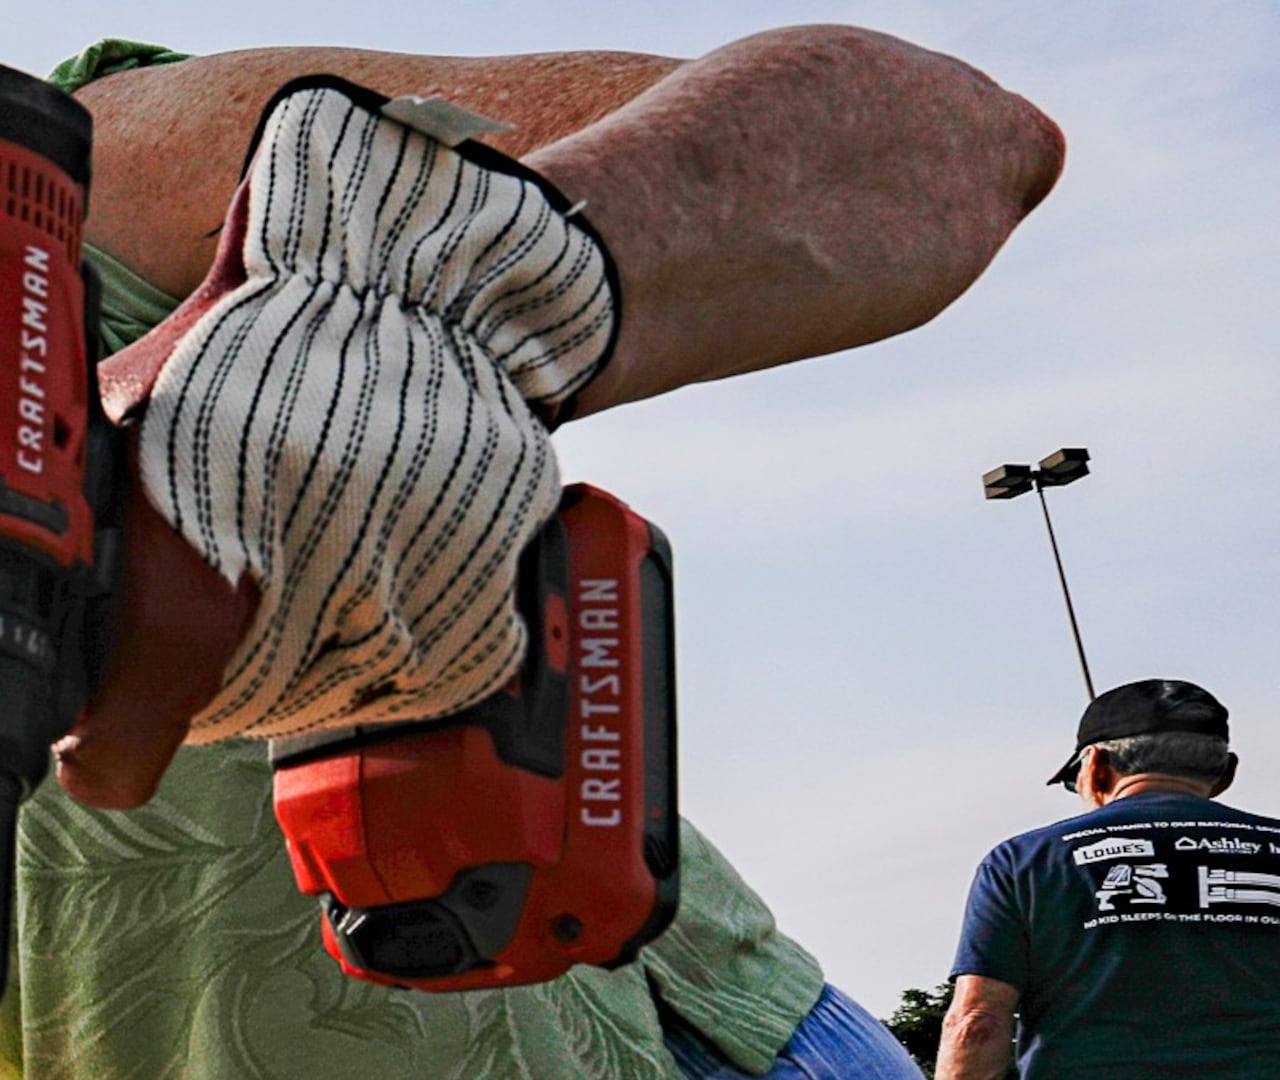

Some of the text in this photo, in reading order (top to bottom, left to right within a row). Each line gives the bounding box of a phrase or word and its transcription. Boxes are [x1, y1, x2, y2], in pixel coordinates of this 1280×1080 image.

[17, 245, 51, 475] CRAFTSMAN
[579, 578, 622, 828] CRAFTSMAN
[1153, 821, 1170, 829] TO
[1082, 843, 1146, 860] LOWE'S
[1198, 836, 1262, 855] Ashley
[1083, 918, 1098, 930] NO
[1098, 915, 1120, 925] KID
[1120, 912, 1162, 922] SLEEPS
[1178, 912, 1201, 922] THE
[1203, 913, 1243, 923] FLOOR
[1244, 915, 1259, 924] IN
[1260, 915, 1280, 925] OU
